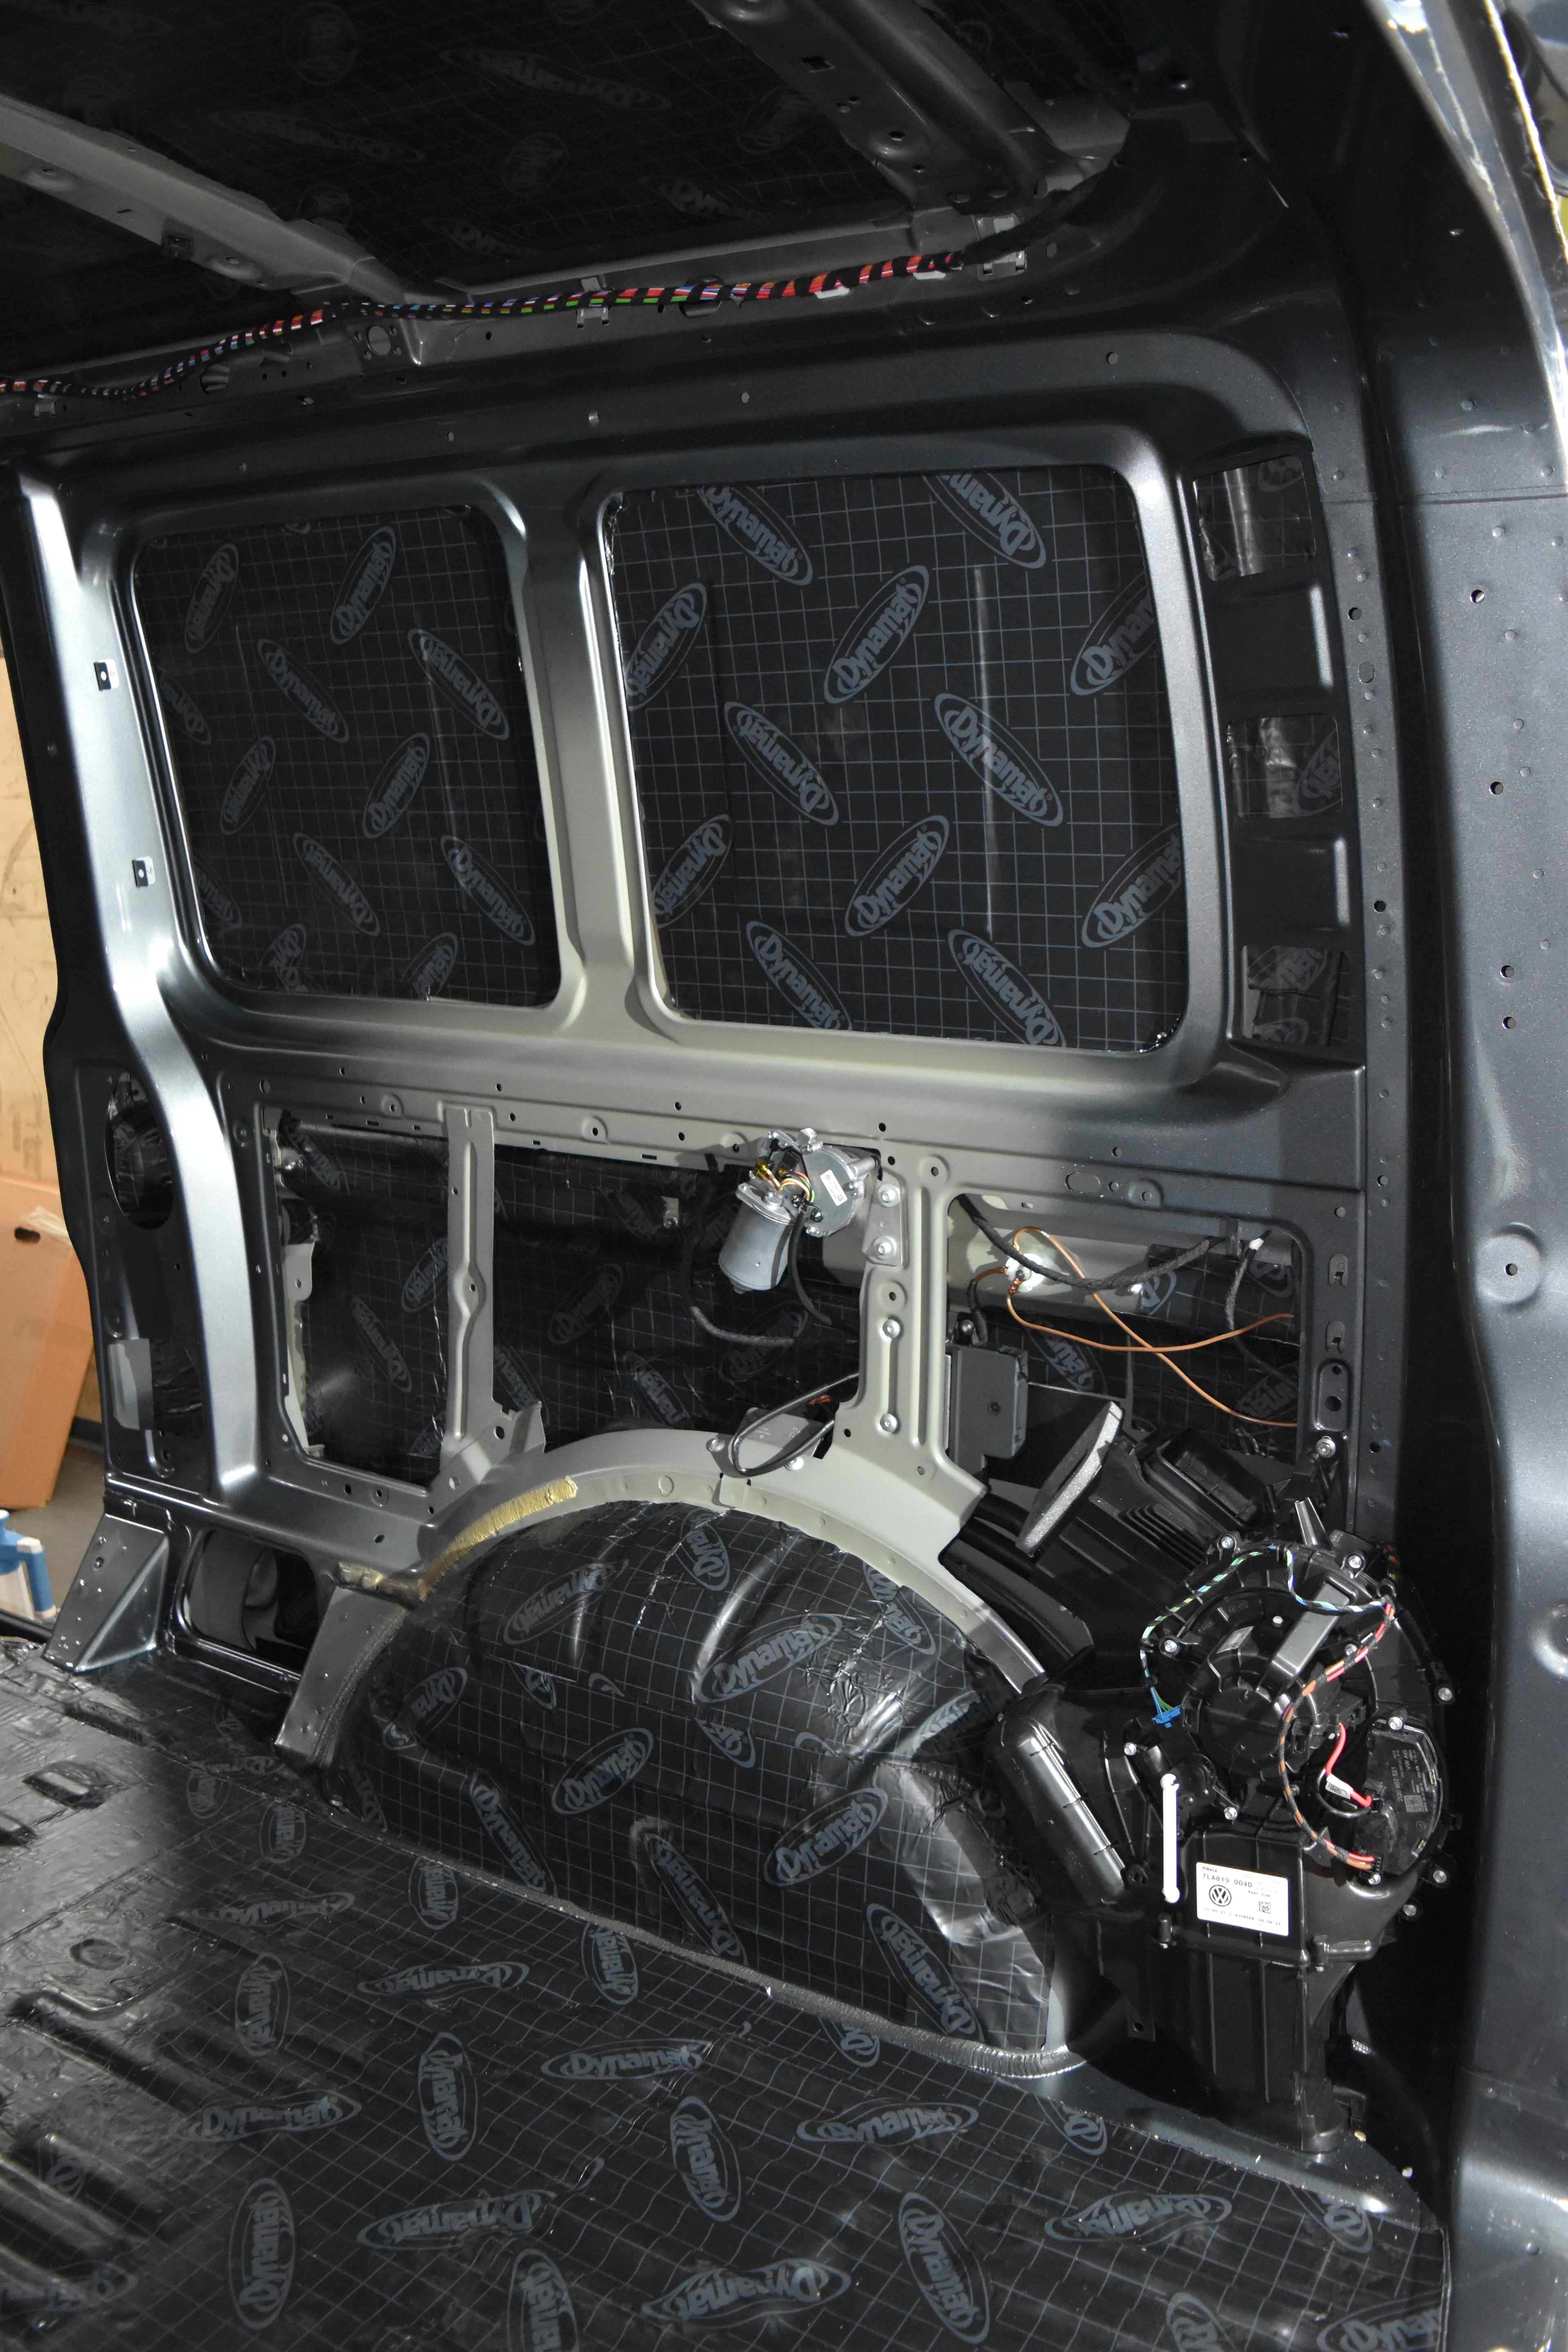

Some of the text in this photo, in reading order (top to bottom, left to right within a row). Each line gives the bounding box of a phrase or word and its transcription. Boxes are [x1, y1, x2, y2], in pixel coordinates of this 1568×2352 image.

[708, 487, 799, 577] Dynamat
[943, 474, 1030, 555] Dynam
[335, 542, 392, 634] Dynamat
[832, 583, 920, 689] Dynamat
[270, 649, 338, 734] Dynamat
[420, 637, 499, 728] Dynamat
[368, 748, 425, 831] Dynamat
[738, 712, 824, 813] Dynamat
[947, 708, 1047, 815] Dynamat
[454, 846, 524, 937] Dynamat
[654, 827, 726, 915] Dynamat
[854, 831, 941, 923] Dynamat
[760, 934, 840, 1028] Dynamat
[963, 940, 1055, 1045] Dynamat
[713, 1615, 829, 1695] Dynamat
[561, 1738, 646, 1806] Dynamat
[1402, 1750, 1410, 1770] VW AG
[475, 1787, 546, 1890] Dynamat
[776, 1799, 877, 1878] Dynamat
[1203, 1873, 1229, 1883] 7LA819
[656, 1843, 737, 1956] Dynamat
[880, 1916, 971, 2034] Dynamat
[424, 2053, 468, 2148] Dynamat
[572, 2045, 702, 2076] Dynamat
[203, 2096, 342, 2136] Dynamat
[675, 2115, 728, 2207] Dynamat
[238, 2194, 285, 2305] Dynamat
[906, 2212, 978, 2327] Dynamat
